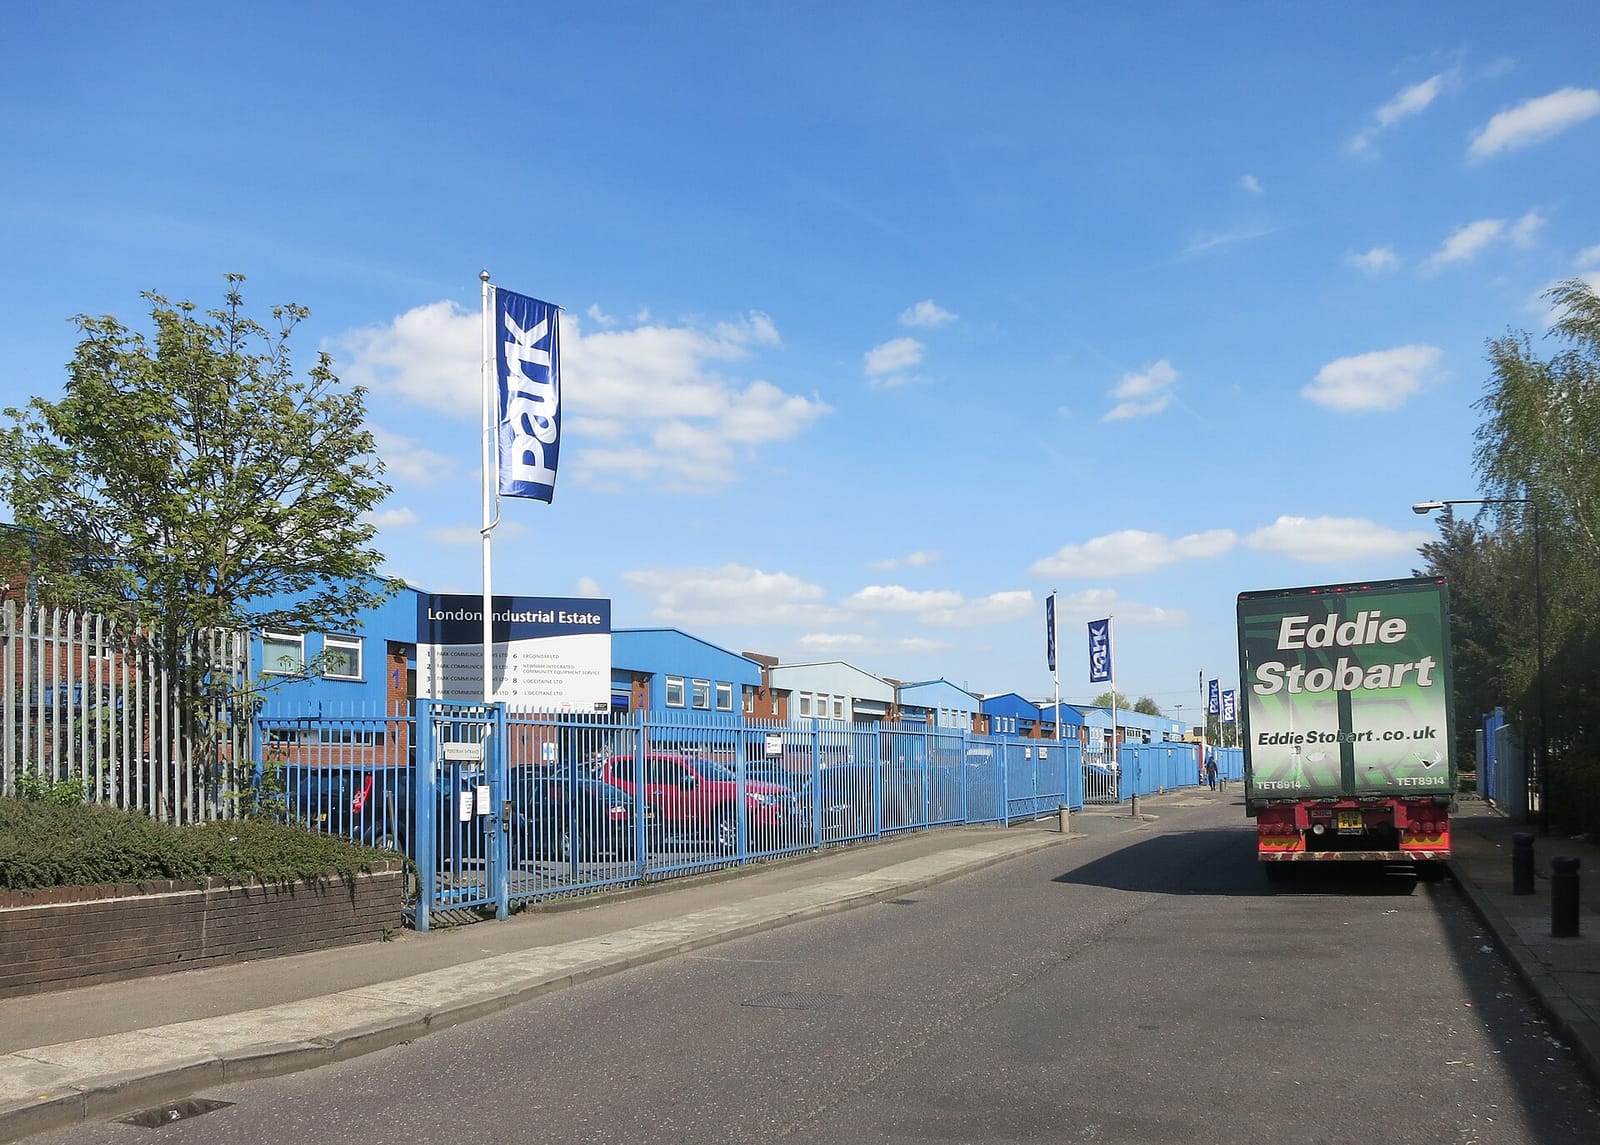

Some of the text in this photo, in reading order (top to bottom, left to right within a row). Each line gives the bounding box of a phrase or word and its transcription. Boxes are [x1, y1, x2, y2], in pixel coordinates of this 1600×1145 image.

[428, 607, 601, 624] London ndustrial Estate
[1276, 610, 1407, 650] Eddie
[1253, 655, 1436, 695] Stobart
[1256, 780, 1302, 790] TET8914
[1396, 776, 1445, 786] TET8914
